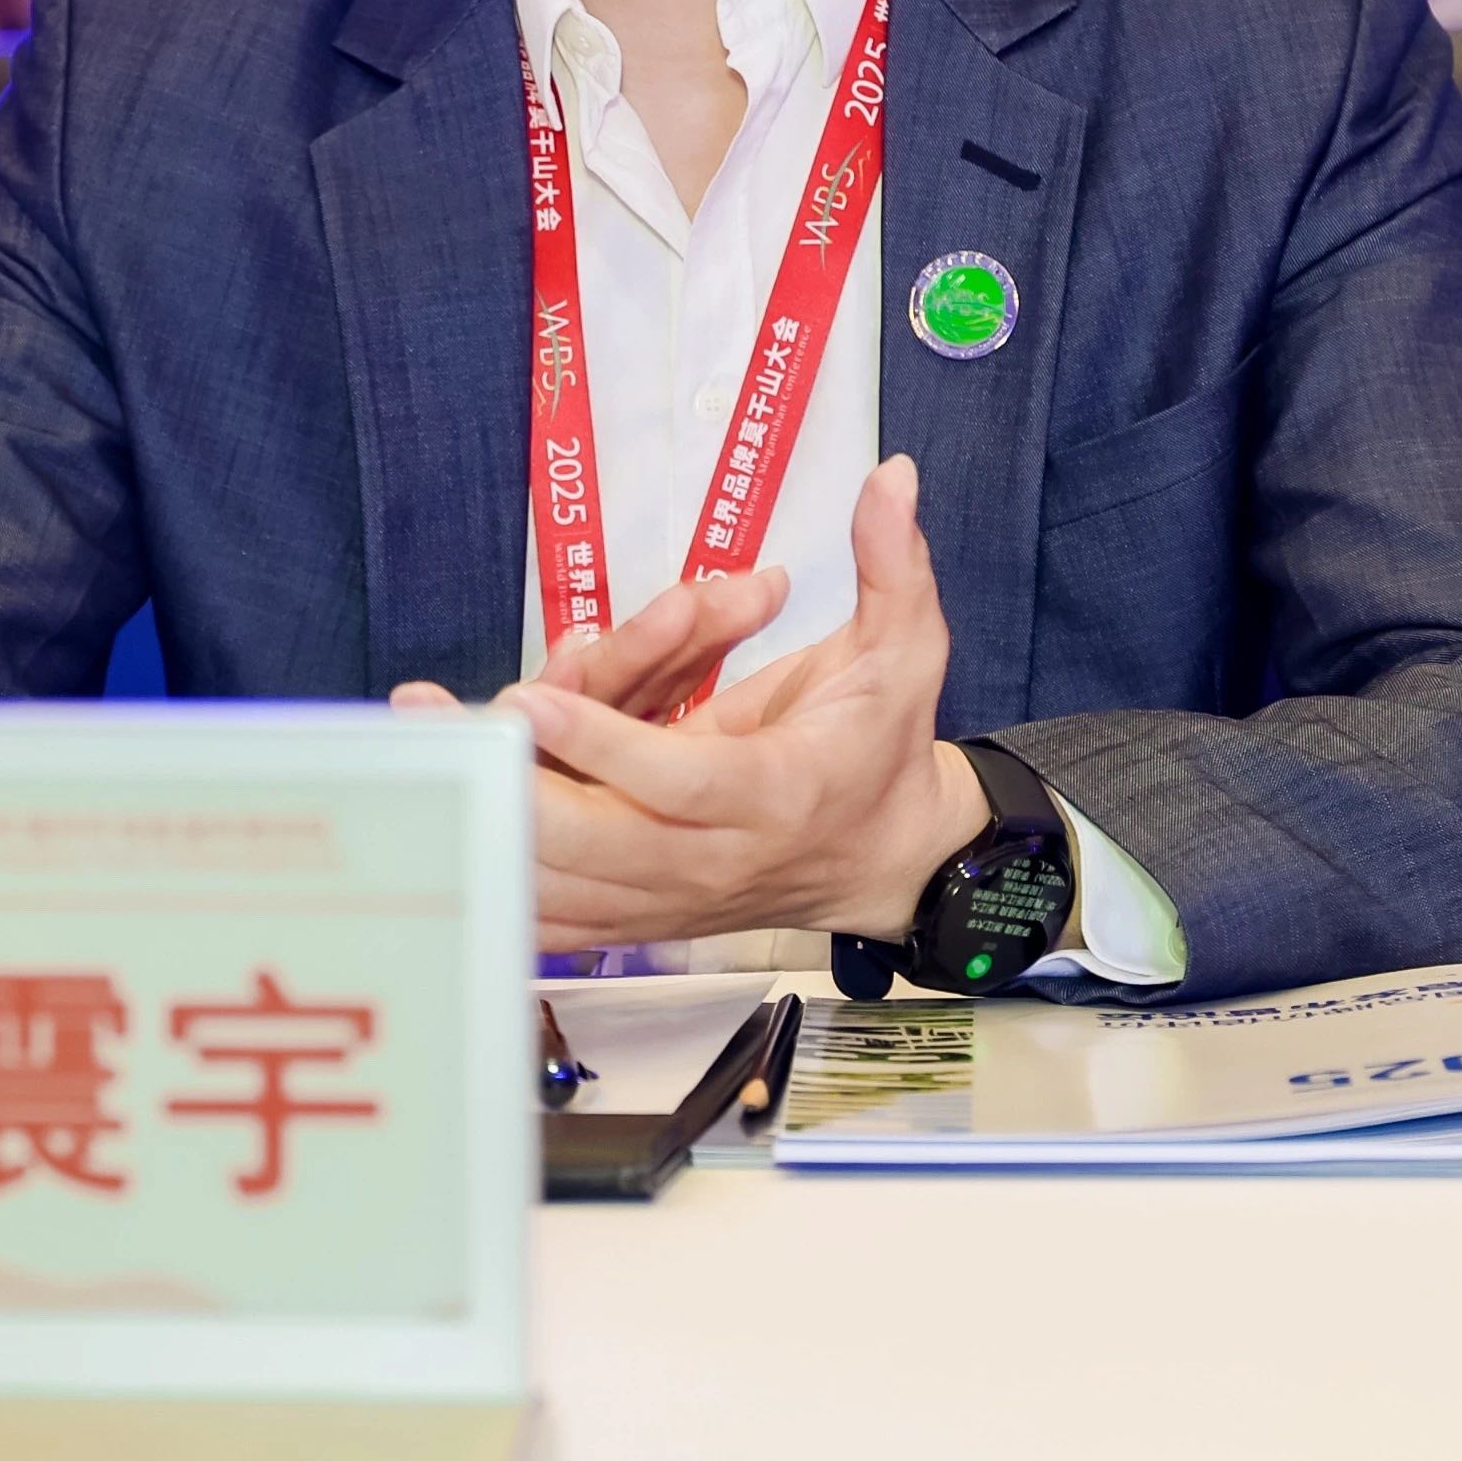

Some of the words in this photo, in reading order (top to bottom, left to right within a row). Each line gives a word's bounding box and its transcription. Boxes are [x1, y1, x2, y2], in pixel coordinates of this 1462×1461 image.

[844, 36, 888, 127] 2025
[799, 162, 856, 247] WBS
[538, 298, 578, 392] WBS
[704, 315, 801, 550] 世界品牌莫干山大会
[545, 436, 588, 527] 2025
